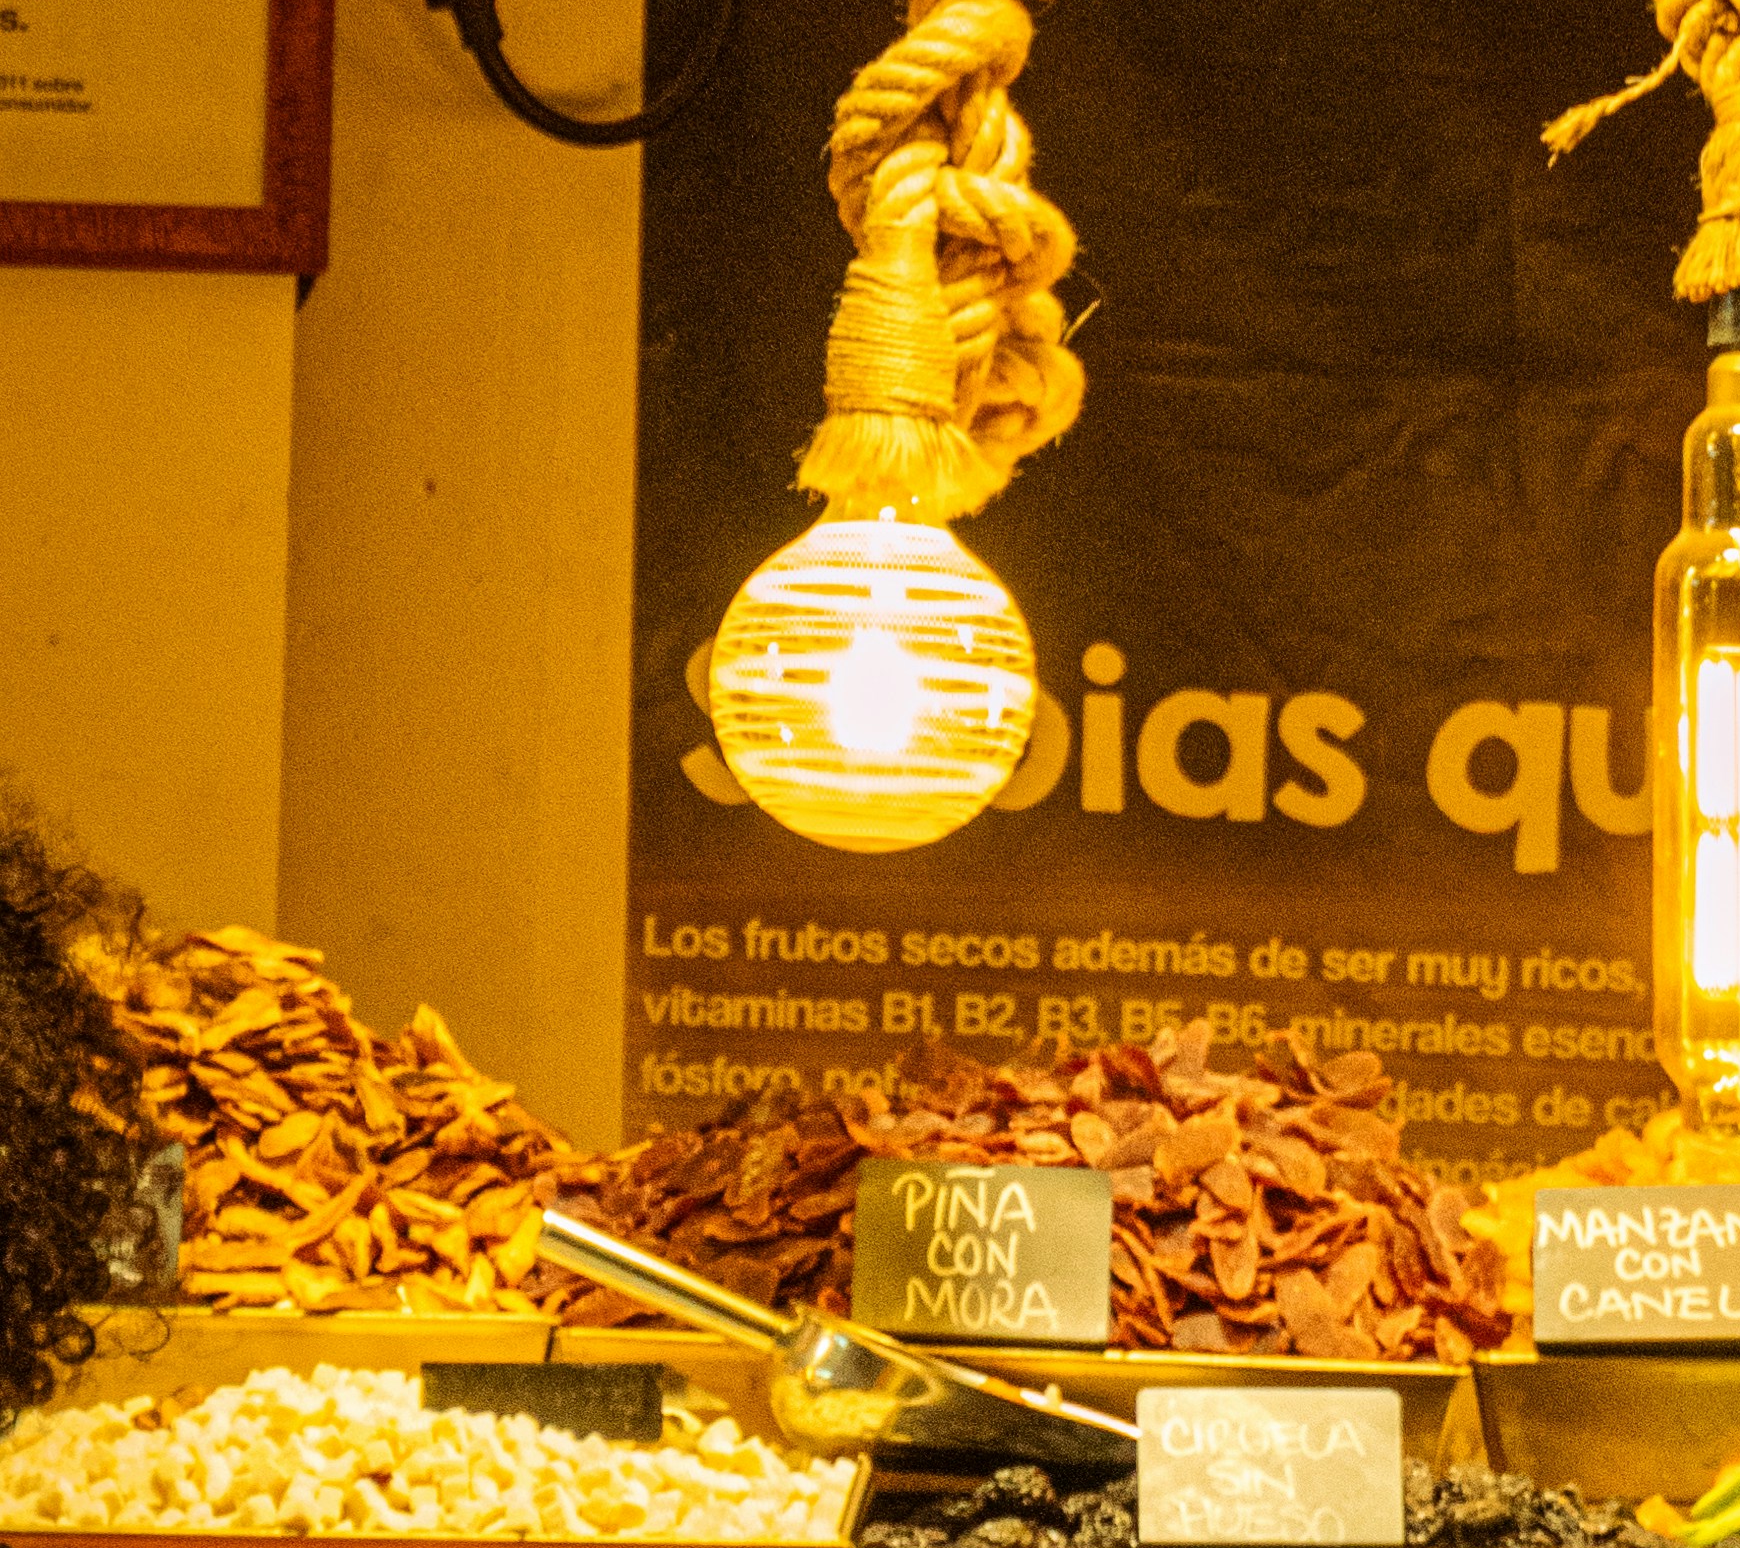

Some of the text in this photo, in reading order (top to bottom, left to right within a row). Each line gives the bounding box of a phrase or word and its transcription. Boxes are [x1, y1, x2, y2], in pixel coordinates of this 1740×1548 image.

[643, 914, 731, 960] Los
[743, 916, 890, 964] frutos
[900, 930, 1041, 968] secos
[1053, 929, 1236, 978] además
[1249, 936, 1309, 980] de
[1321, 947, 1397, 984] ser
[1406, 950, 1509, 1001] muy
[1521, 948, 1648, 1001] ricos,
[642, 985, 870, 1033] vitaminas
[1290, 1007, 1511, 1056] minerales
[1532, 1083, 1593, 1127] de
[891, 1167, 1037, 1233] PIÑA
[927, 1230, 1020, 1280] CON
[1613, 1246, 1703, 1282] CON
[903, 1276, 1059, 1333] MORA
